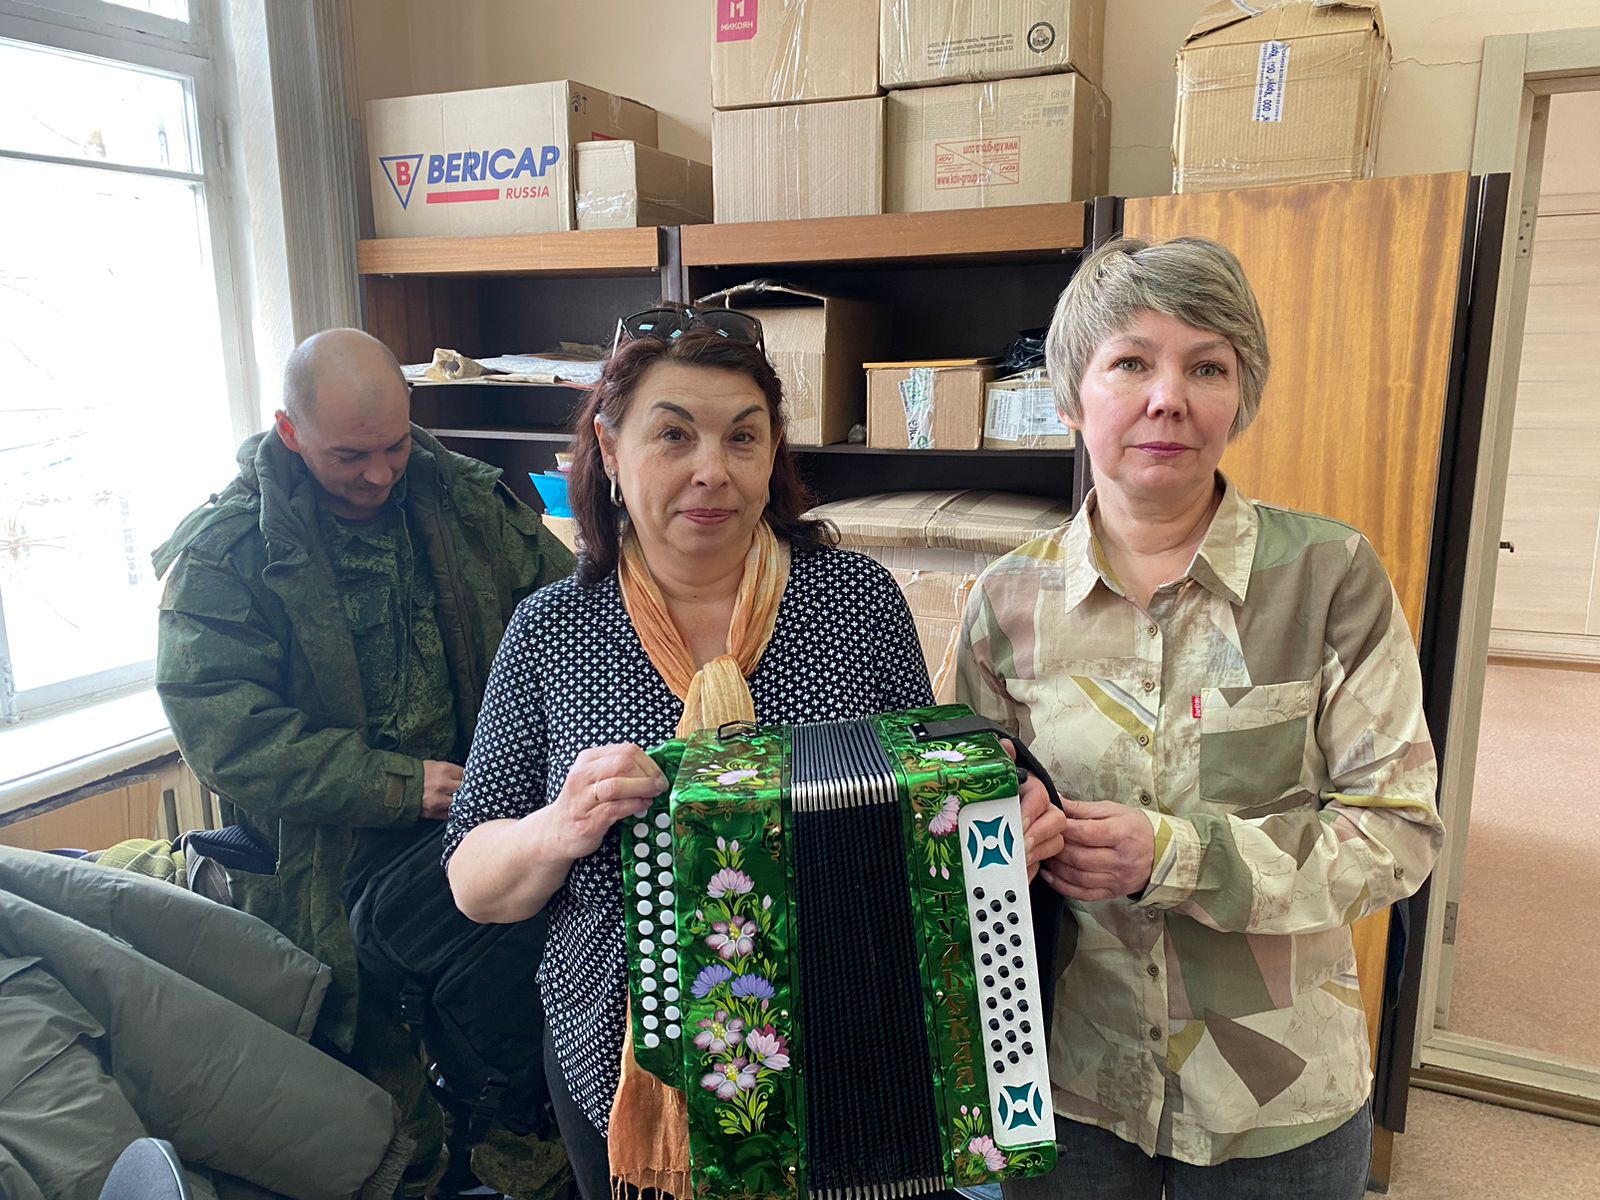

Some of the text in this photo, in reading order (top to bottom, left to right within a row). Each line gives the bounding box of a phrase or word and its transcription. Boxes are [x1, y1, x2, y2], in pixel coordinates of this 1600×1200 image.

[720, 20, 753, 31] МИКОЯН
[396, 161, 411, 186] B
[427, 145, 560, 184] BERICAP
[505, 185, 550, 200] RUSSIA
